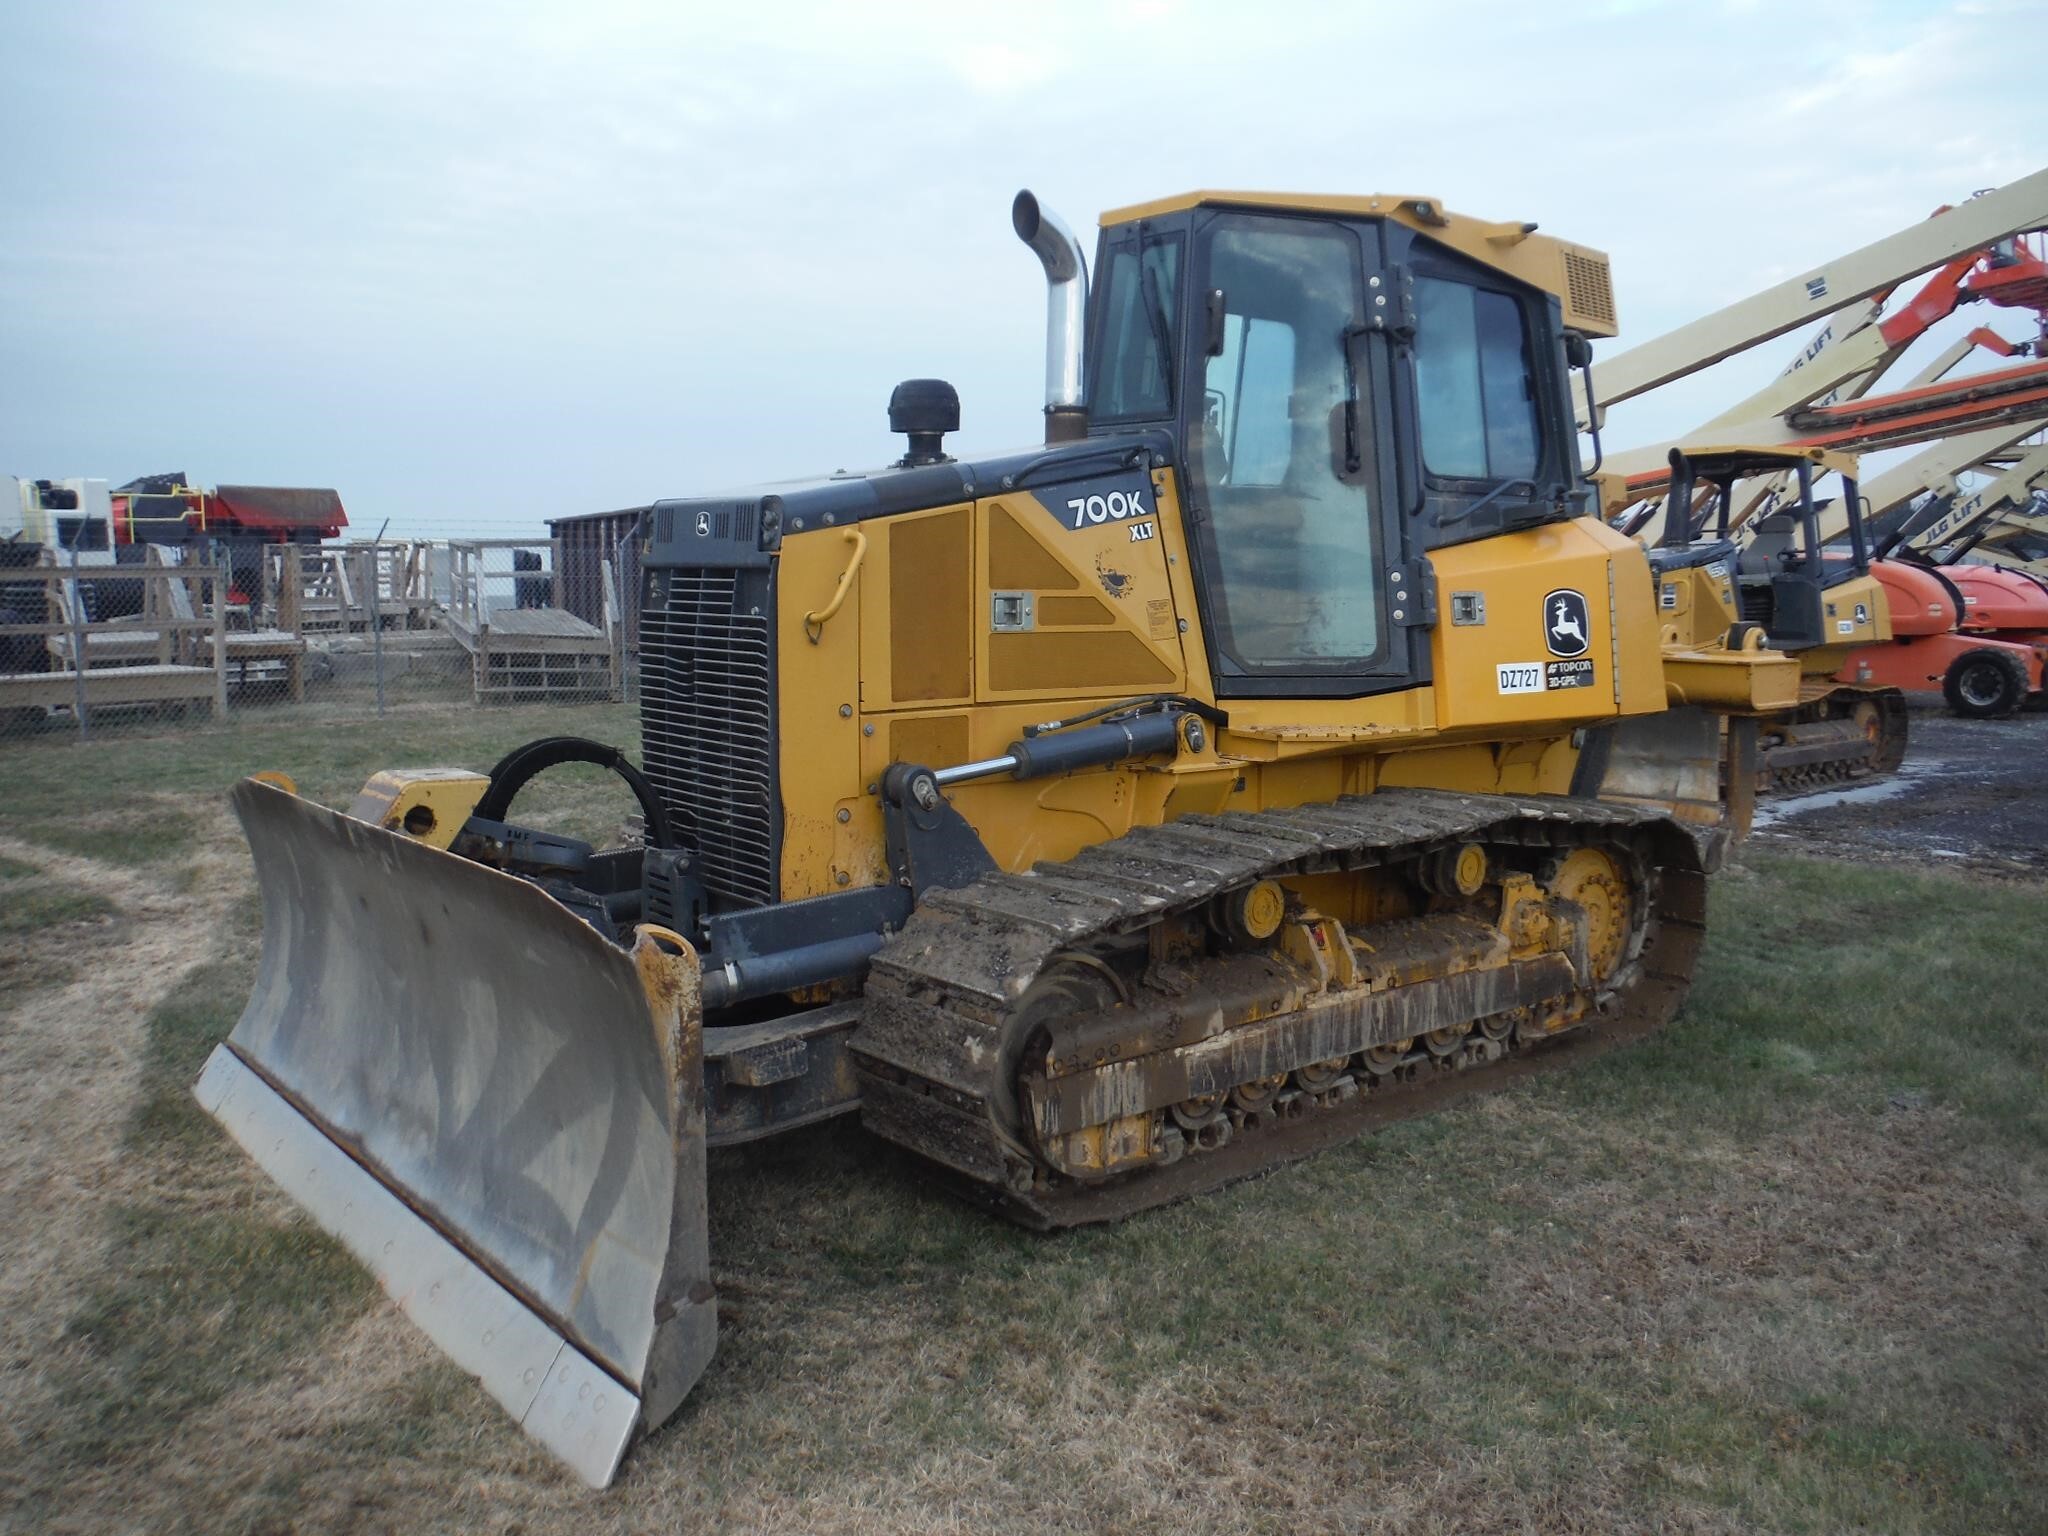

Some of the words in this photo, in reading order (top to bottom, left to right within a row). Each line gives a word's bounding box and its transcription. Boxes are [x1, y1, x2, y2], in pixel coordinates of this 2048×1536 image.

[1067, 490, 1147, 527] 700K
[1926, 518, 1949, 545] JLG
[1952, 494, 1981, 525] LIFT
[1128, 522, 1153, 542] XLT
[1500, 669, 1539, 689] DZ727
